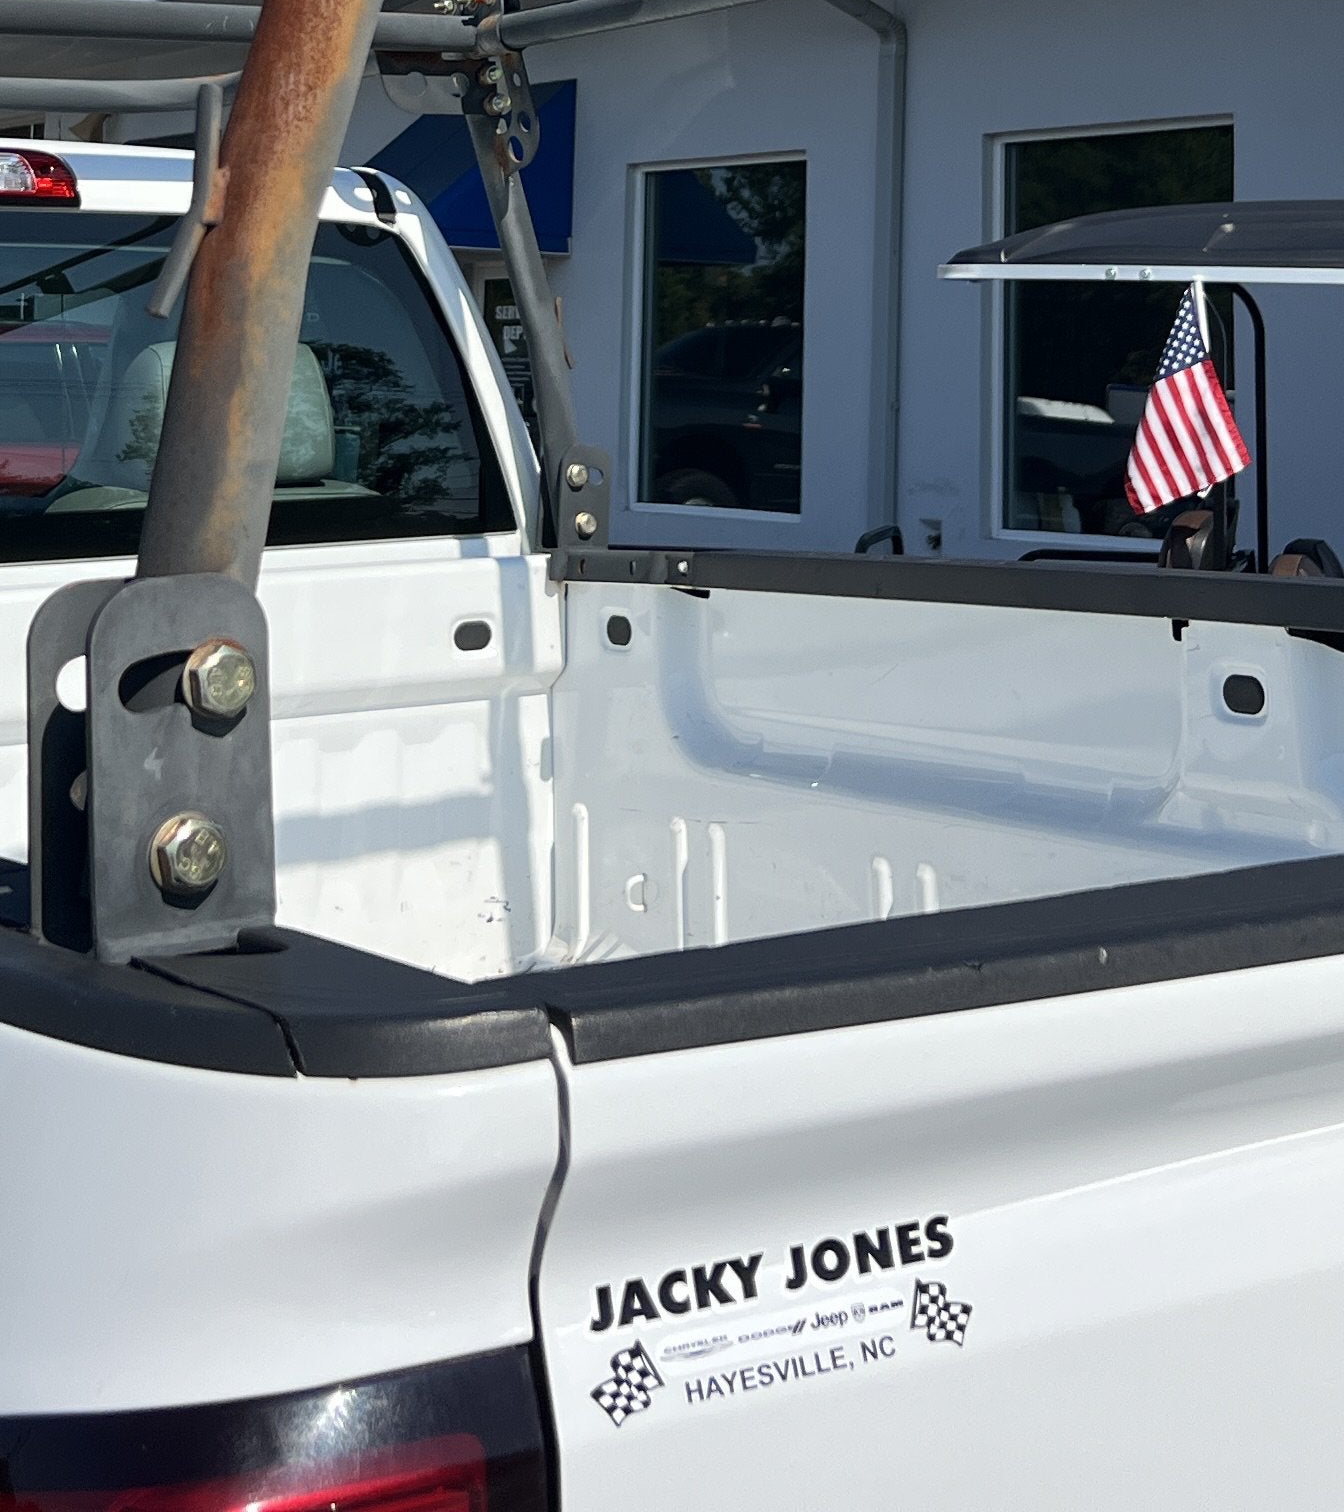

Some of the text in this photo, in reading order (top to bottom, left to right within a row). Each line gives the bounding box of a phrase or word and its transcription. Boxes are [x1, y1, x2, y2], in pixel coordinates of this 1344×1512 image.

[502, 325, 526, 340] DEP
[589, 1213, 955, 1333] JACKY JONES
[810, 1309, 849, 1331] Jeep
[867, 1299, 905, 1314] RAM
[684, 1335, 897, 1404] HAYESVILLE, NC
